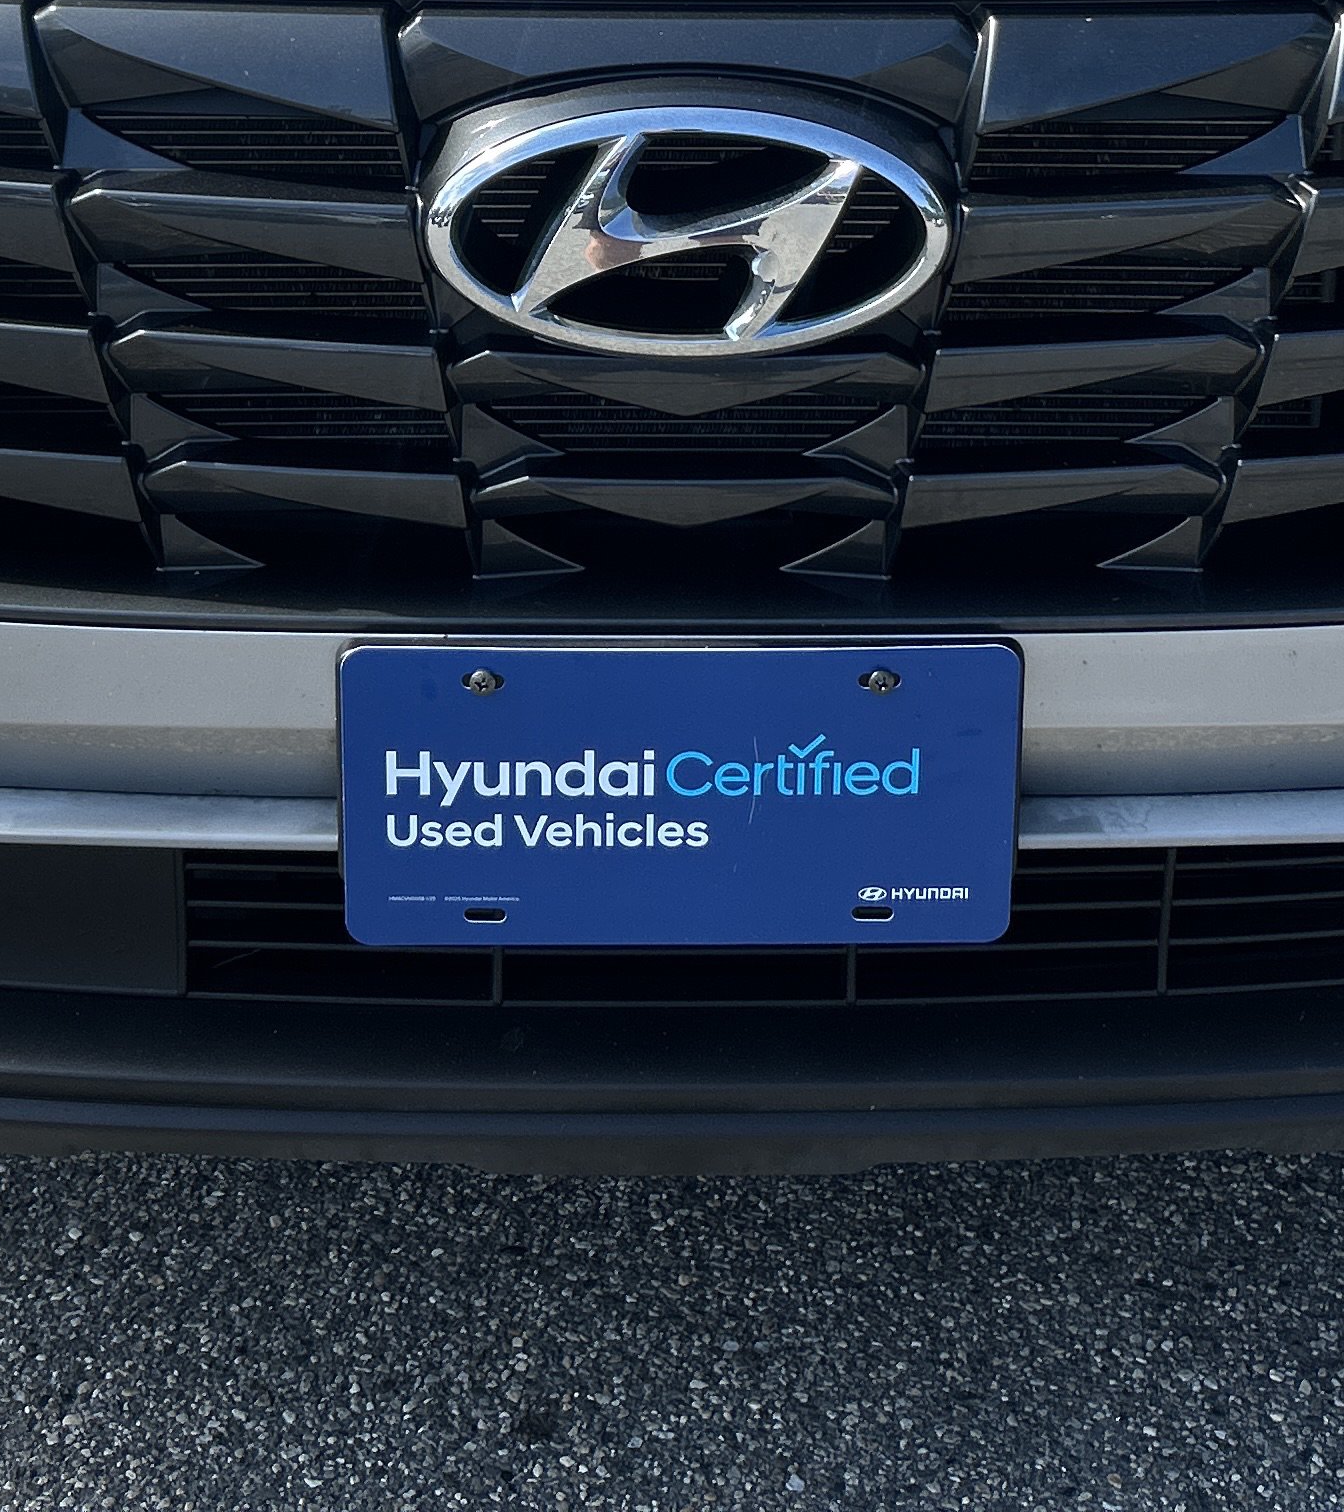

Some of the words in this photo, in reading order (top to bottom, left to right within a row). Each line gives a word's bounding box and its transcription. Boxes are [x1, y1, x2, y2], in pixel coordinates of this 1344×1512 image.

[385, 749, 655, 807] Hyundai
[666, 734, 920, 796] Certified
[386, 813, 503, 847] Used
[513, 812, 709, 847] Vehicles
[891, 887, 969, 900] HYUNDAI
